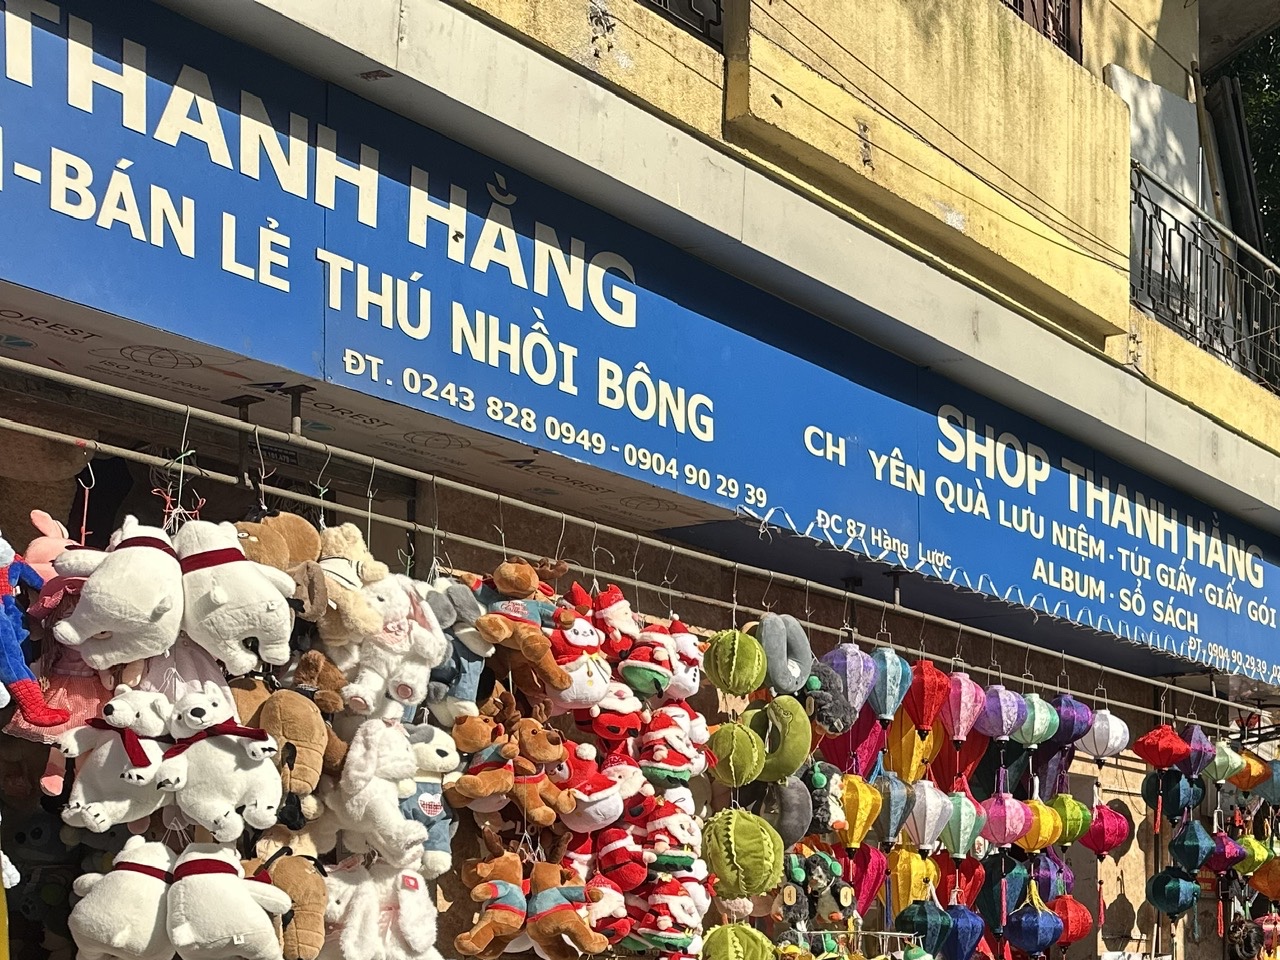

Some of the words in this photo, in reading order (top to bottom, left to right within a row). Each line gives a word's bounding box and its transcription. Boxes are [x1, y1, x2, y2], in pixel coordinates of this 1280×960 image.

[0, 0, 380, 229] THANH
[408, 171, 637, 328] HẰNG
[222, 217, 290, 293] LẺ
[317, 248, 432, 341] THÚ
[452, 301, 578, 396] NHỒI
[598, 357, 714, 443] BÔNG
[403, 367, 476, 412] 0243
[486, 395, 537, 433] 828
[544, 415, 606, 455] 0949
[623, 443, 679, 480] 0904
[684, 463, 711, 490] 90
[716, 474, 739, 498] 29
[744, 483, 768, 508] 39
[937, 404, 1051, 495] SHOP
[1061, 457, 1178, 554] THANH
[1186, 511, 1264, 589] HẰNG
[803, 425, 846, 467] CH
[868, 446, 926, 497] YÊN
[935, 475, 990, 520] QUÀ
[999, 499, 1045, 540] LƯU
[1052, 521, 1105, 563] NIỆM
[1118, 546, 1151, 580] TÚI
[1156, 557, 1197, 597] GIẤY
[1204, 577, 1243, 615] GIẤY
[1247, 596, 1277, 628] GÓI
[816, 509, 843, 534] ĐC
[846, 518, 867, 538] 87
[871, 526, 909, 559] Hàng
[918, 542, 952, 571] Lược
[1032, 557, 1105, 604] ALBUM
[1119, 577, 1146, 616] SỔ
[1152, 596, 1199, 635] SÁCH
[1208, 642, 1229, 660] 0904
[1231, 650, 1242, 666] 90
[1245, 654, 1255, 669] 29
[1256, 659, 1267, 674] 39
